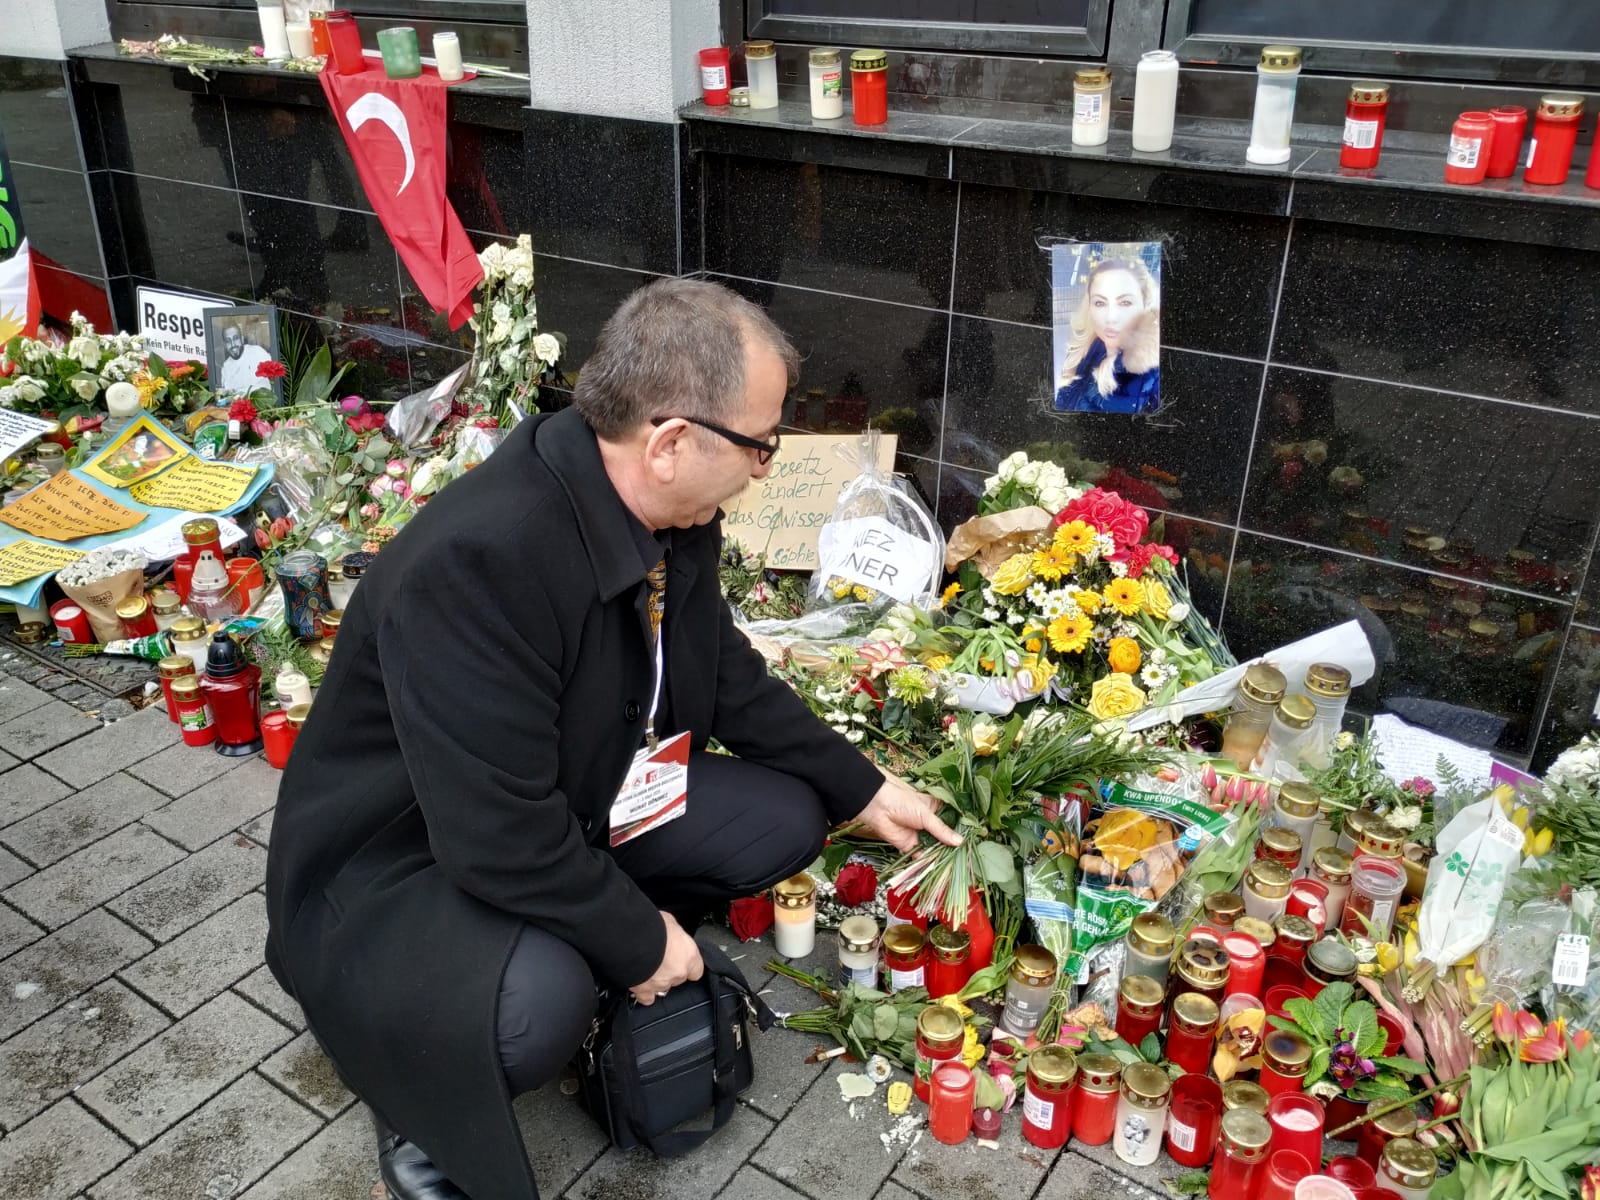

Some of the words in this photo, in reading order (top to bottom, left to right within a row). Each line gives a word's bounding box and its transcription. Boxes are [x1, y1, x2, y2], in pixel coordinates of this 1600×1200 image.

[144, 302, 204, 339] Respe
[146, 338, 162, 349] Kein
[163, 340, 182, 352] Platz
[184, 344, 194, 355] für
[195, 346, 207, 356] Ra
[761, 477, 833, 499] ändert
[727, 498, 755, 525] das
[757, 504, 832, 530] Gewissen
[772, 542, 815, 566] Sophie
[1123, 790, 1142, 800] KWA
